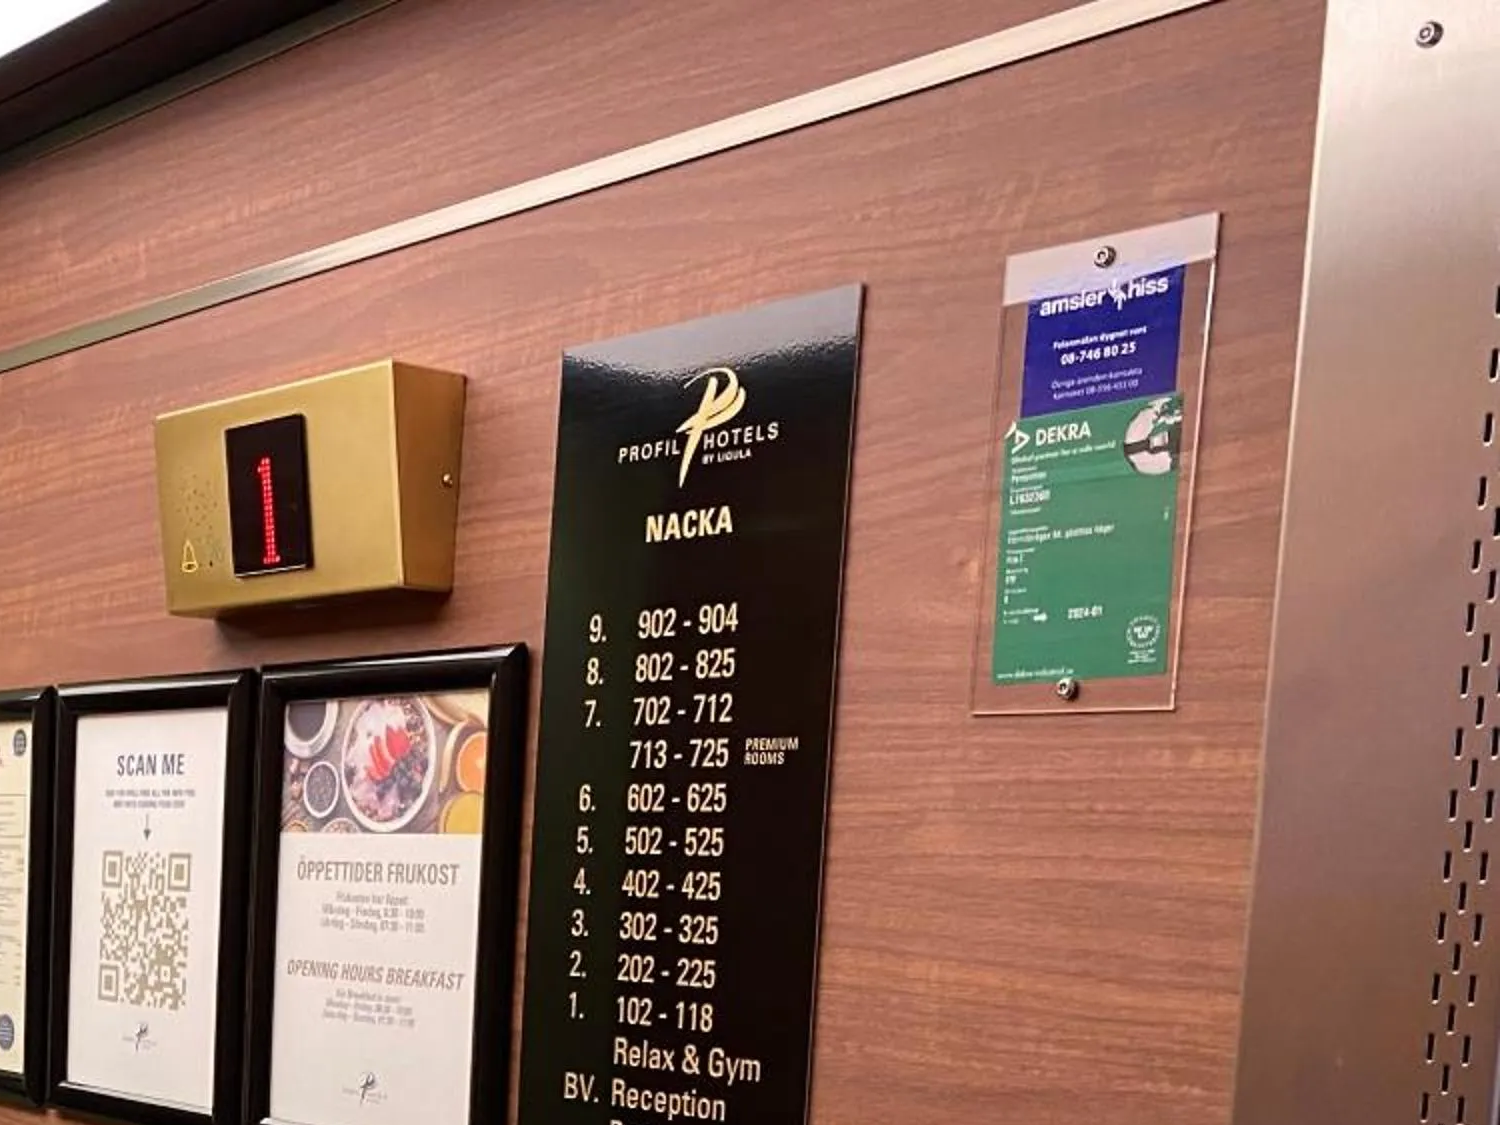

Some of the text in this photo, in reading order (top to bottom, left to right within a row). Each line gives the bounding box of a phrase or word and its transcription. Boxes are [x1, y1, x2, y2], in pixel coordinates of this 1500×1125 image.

[1039, 276, 1168, 317] amsler hiss
[1121, 341, 1136, 354] 25
[618, 422, 779, 463] PROFIL HOTELS
[1035, 421, 1092, 446] DEKRA
[702, 448, 752, 465] BY LIGULA
[257, 457, 281, 565] 1
[645, 506, 733, 543] NACKA
[589, 614, 607, 643] 9.
[638, 607, 676, 639] 902
[698, 602, 739, 634] 904
[586, 658, 604, 685] 8.
[635, 652, 673, 683] 802
[695, 647, 736, 678] 825
[584, 701, 601, 728] 7.
[633, 696, 671, 726] 702
[693, 694, 733, 724] 712
[629, 740, 668, 770] 713
[690, 738, 729, 768] 725
[744, 751, 785, 765] ROOMS
[745, 737, 799, 752] PREMIUM
[117, 753, 185, 776] SCAN ME
[579, 785, 596, 811] 6.
[627, 784, 665, 813] 602
[687, 783, 727, 813] 625
[576, 827, 593, 854] 5.
[624, 827, 663, 855] 502
[684, 827, 725, 857] 525
[297, 855, 460, 886] ÖPPETTIDER FRUKOST
[573, 868, 591, 896] 4.
[621, 870, 660, 899] 402
[681, 872, 721, 901] 425
[571, 909, 589, 938] 3.
[618, 911, 657, 941] 302
[678, 915, 719, 945] 325
[287, 959, 466, 992] OPENING HOURS BREAKFAST
[569, 950, 587, 979] 2.
[617, 954, 656, 984] 202
[676, 958, 716, 989] 225
[569, 992, 585, 1020] 1.
[616, 996, 653, 1028] 102
[675, 1002, 713, 1033] 118
[613, 1037, 761, 1084] Relax & Gym
[564, 1072, 726, 1122] BV. Reception
